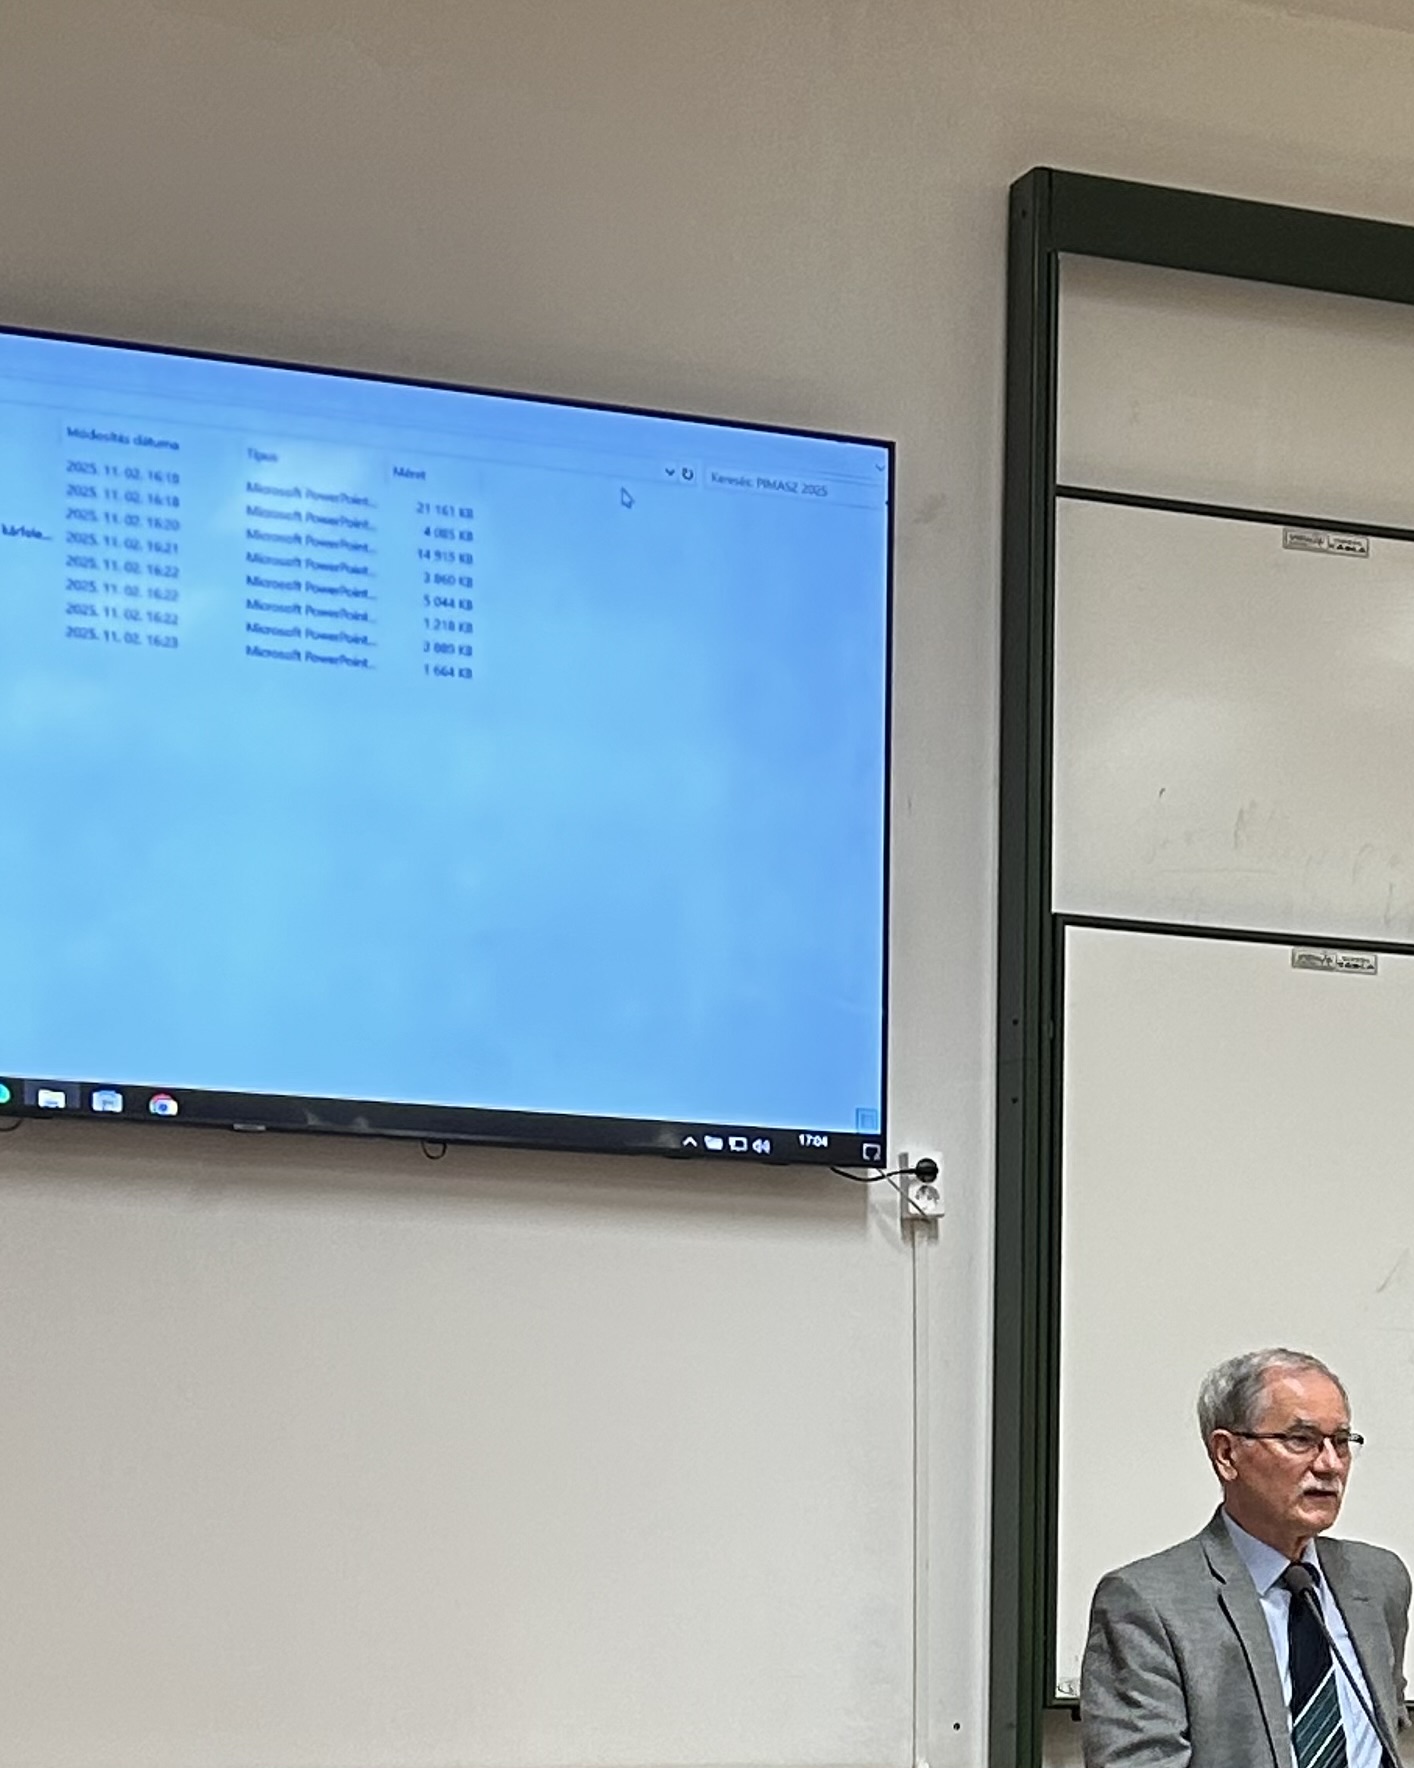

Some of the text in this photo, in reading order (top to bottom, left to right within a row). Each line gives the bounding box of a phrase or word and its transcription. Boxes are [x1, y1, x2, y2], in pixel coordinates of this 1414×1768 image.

[246, 482, 302, 498] Microsoft
[246, 504, 302, 521] Microsoft
[416, 500, 430, 514] 21
[246, 528, 302, 544] Microsoft
[246, 551, 302, 568] Microsoft
[418, 548, 430, 560] 14
[246, 575, 302, 592] Microsoft
[246, 598, 302, 616] Microsoft
[246, 622, 302, 638] Microsoft
[246, 645, 302, 662] Microsoft
[798, 1134, 828, 1148] 17:04
